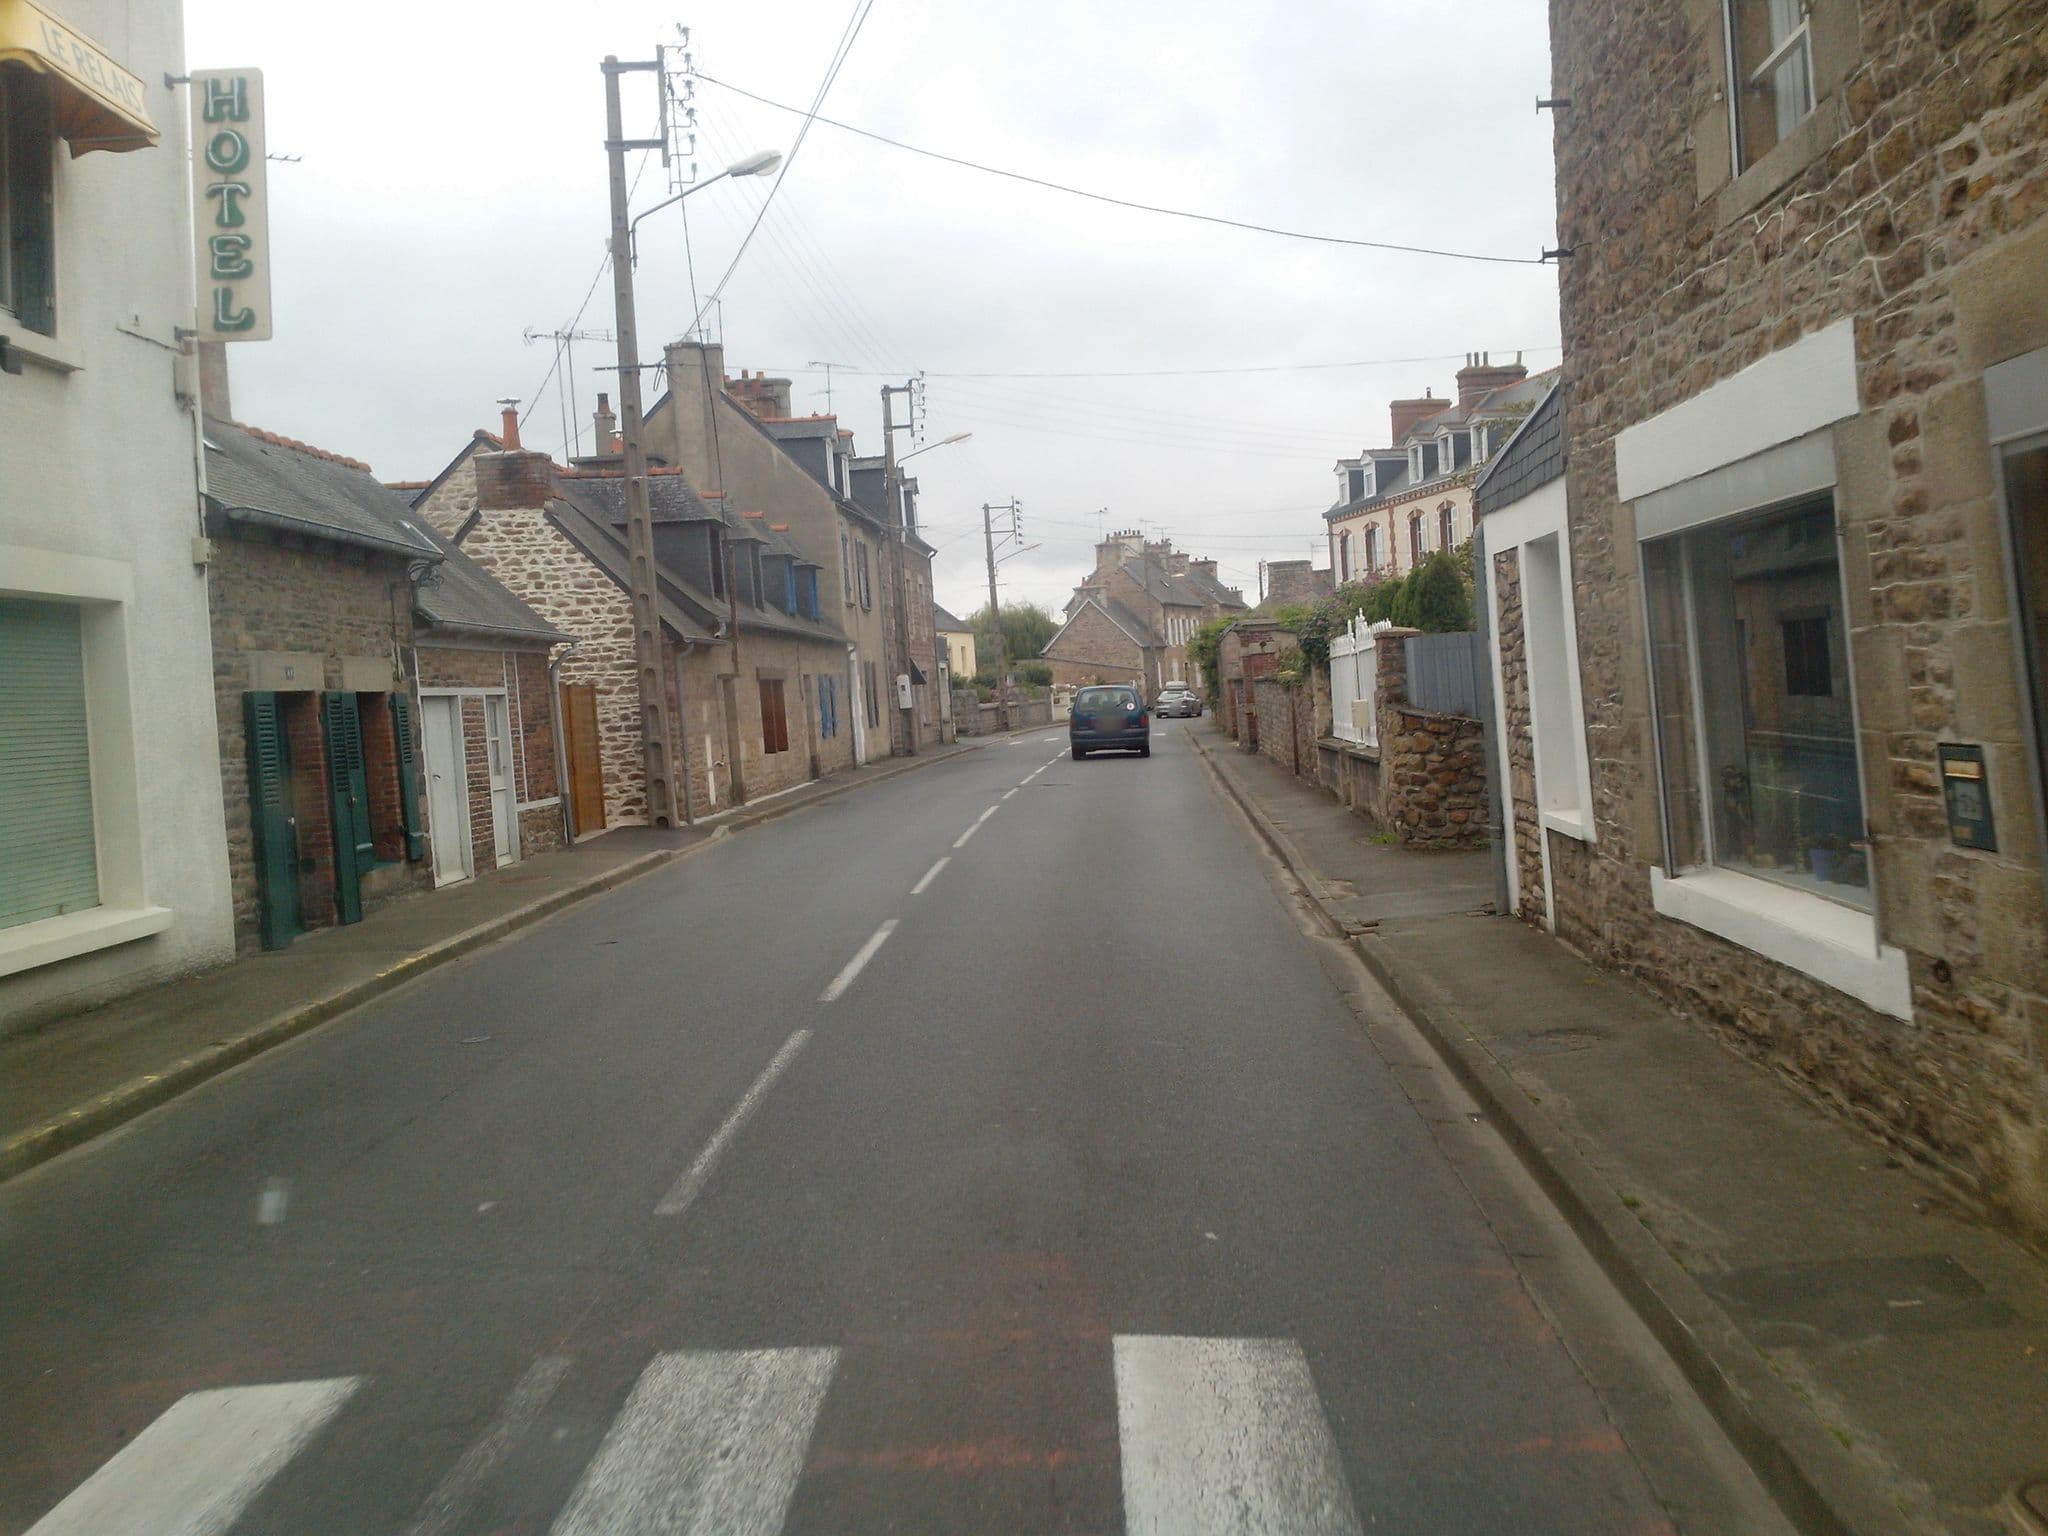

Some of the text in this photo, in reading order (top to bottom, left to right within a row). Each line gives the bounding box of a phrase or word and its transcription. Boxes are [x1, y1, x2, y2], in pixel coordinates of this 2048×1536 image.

[40, 20, 143, 114] LE RELAIS
[203, 77, 255, 332] HOTEL
